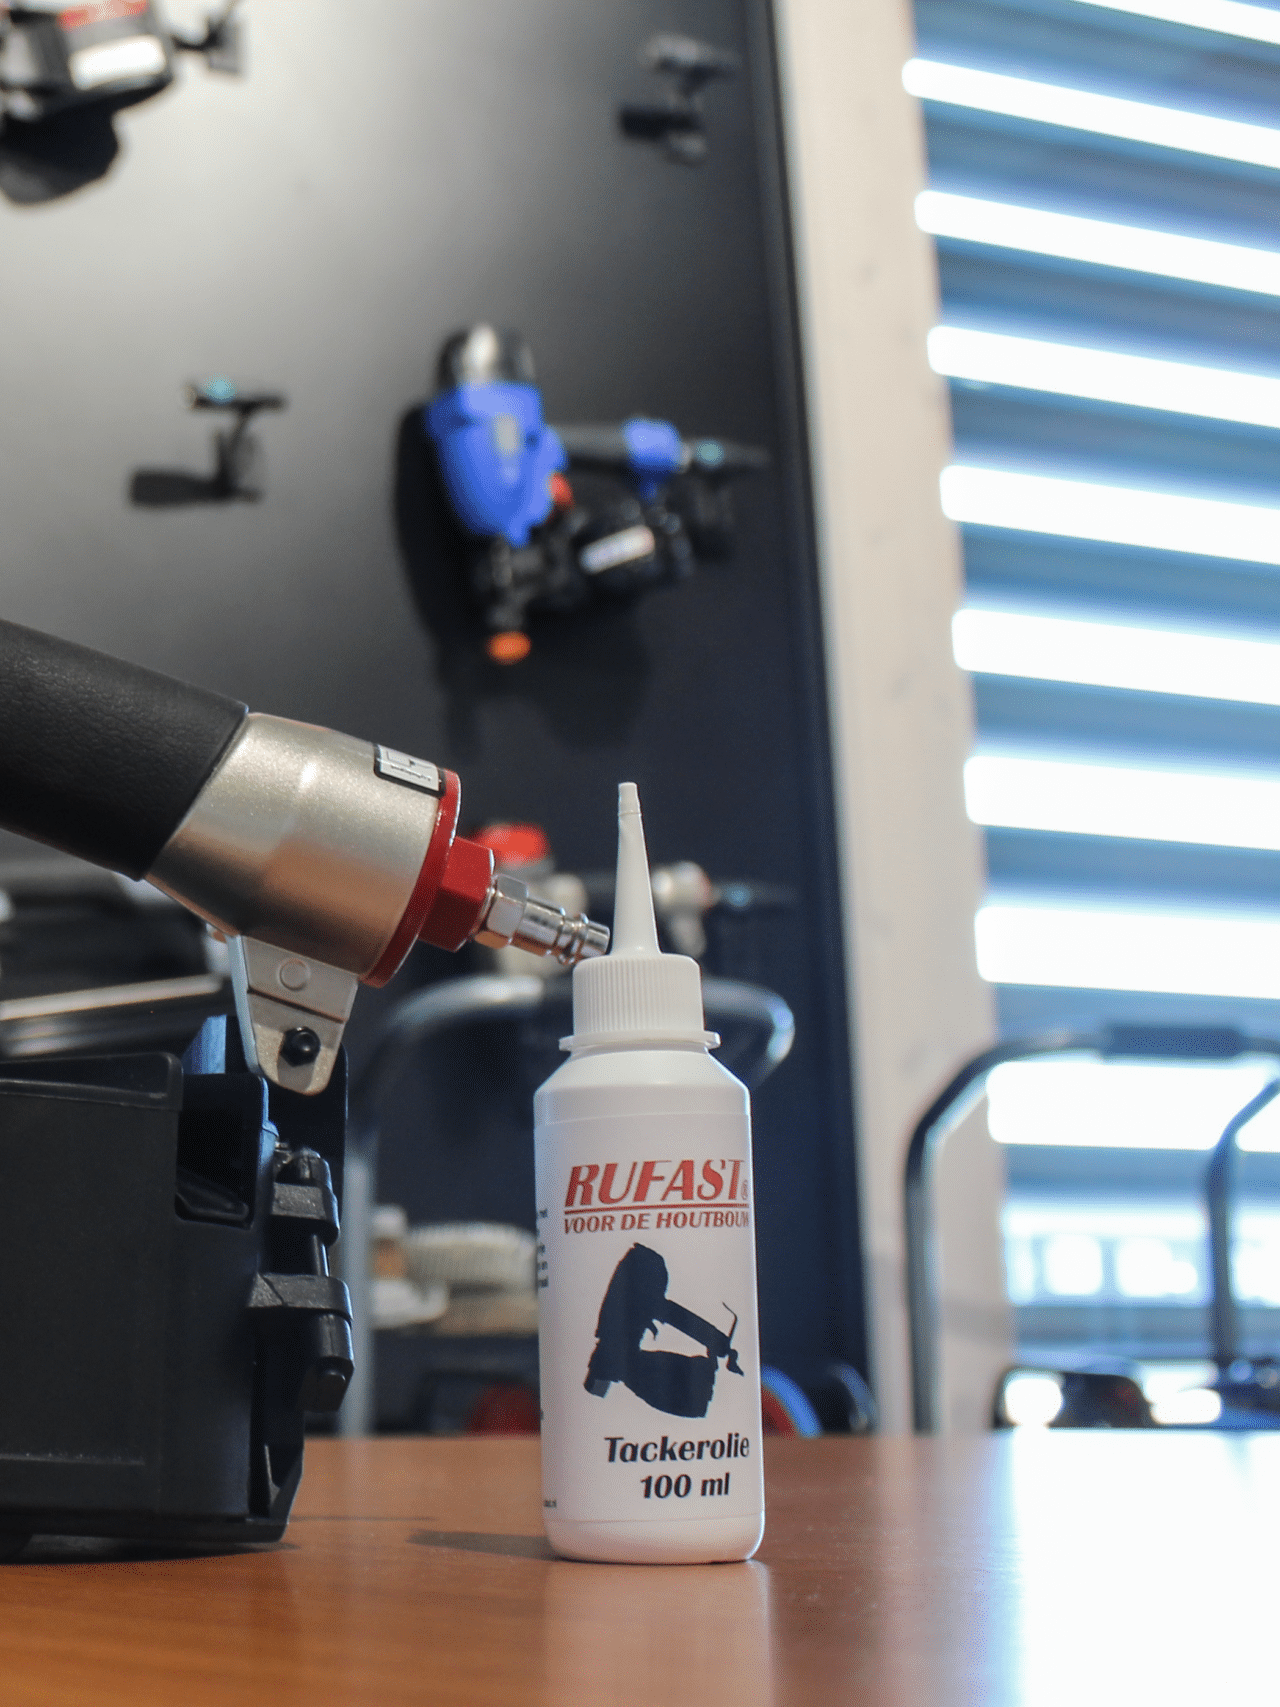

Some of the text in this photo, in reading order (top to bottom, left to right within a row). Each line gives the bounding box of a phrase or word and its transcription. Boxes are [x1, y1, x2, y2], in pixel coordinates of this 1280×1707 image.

[564, 1216, 615, 1234] VOOR
[621, 1214, 650, 1231] DE
[605, 1433, 750, 1463] Tackerolie
[640, 1473, 730, 1499] 100 ml
